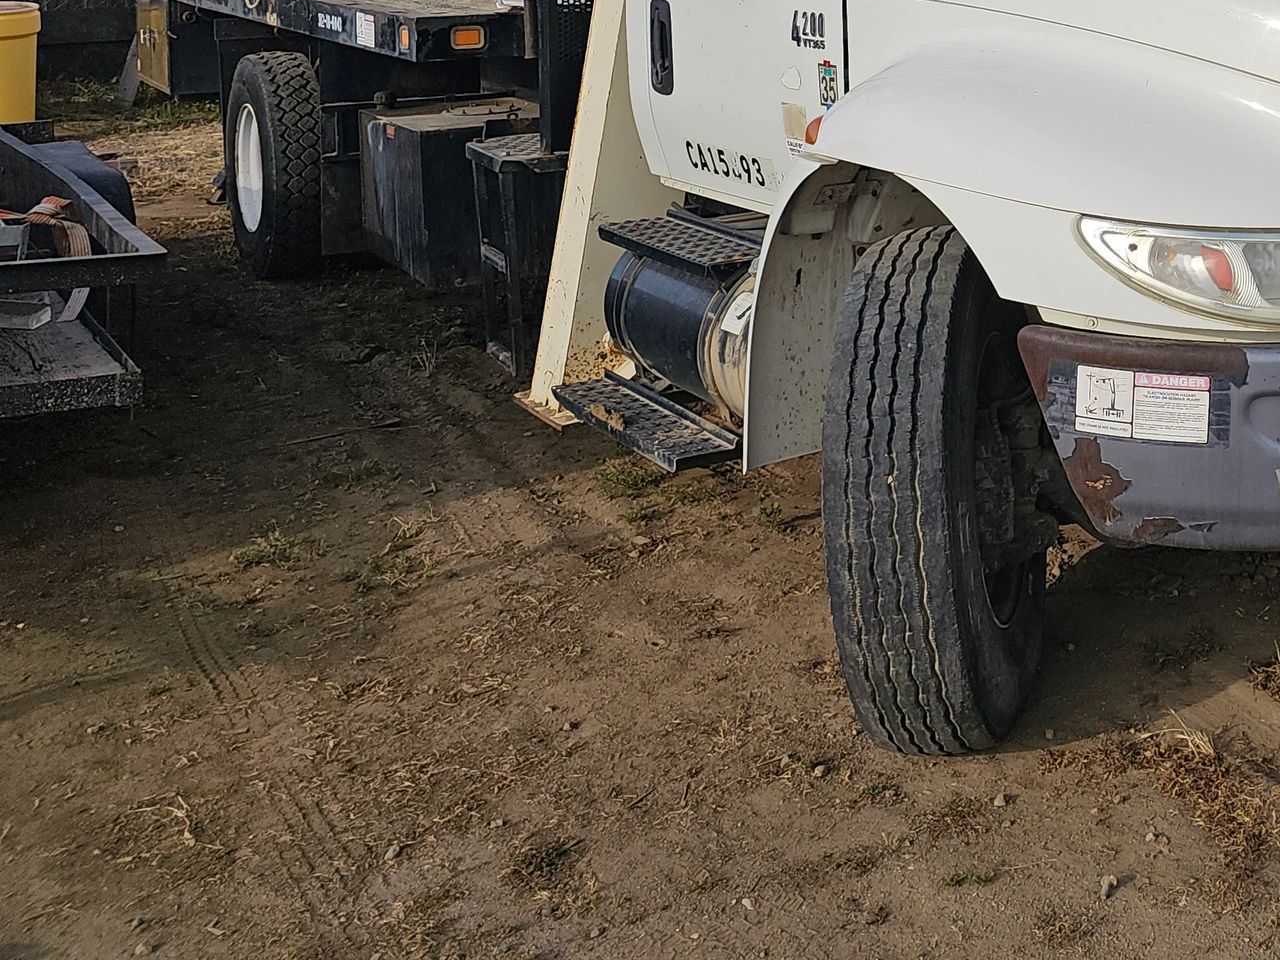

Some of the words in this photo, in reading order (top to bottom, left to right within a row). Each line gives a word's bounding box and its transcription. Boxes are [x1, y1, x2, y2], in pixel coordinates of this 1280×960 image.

[792, 10, 824, 47] 4200
[803, 38, 825, 49] VT365
[822, 76, 836, 104] 35
[686, 140, 765, 187] CA1593
[1152, 375, 1206, 388] DANGER
